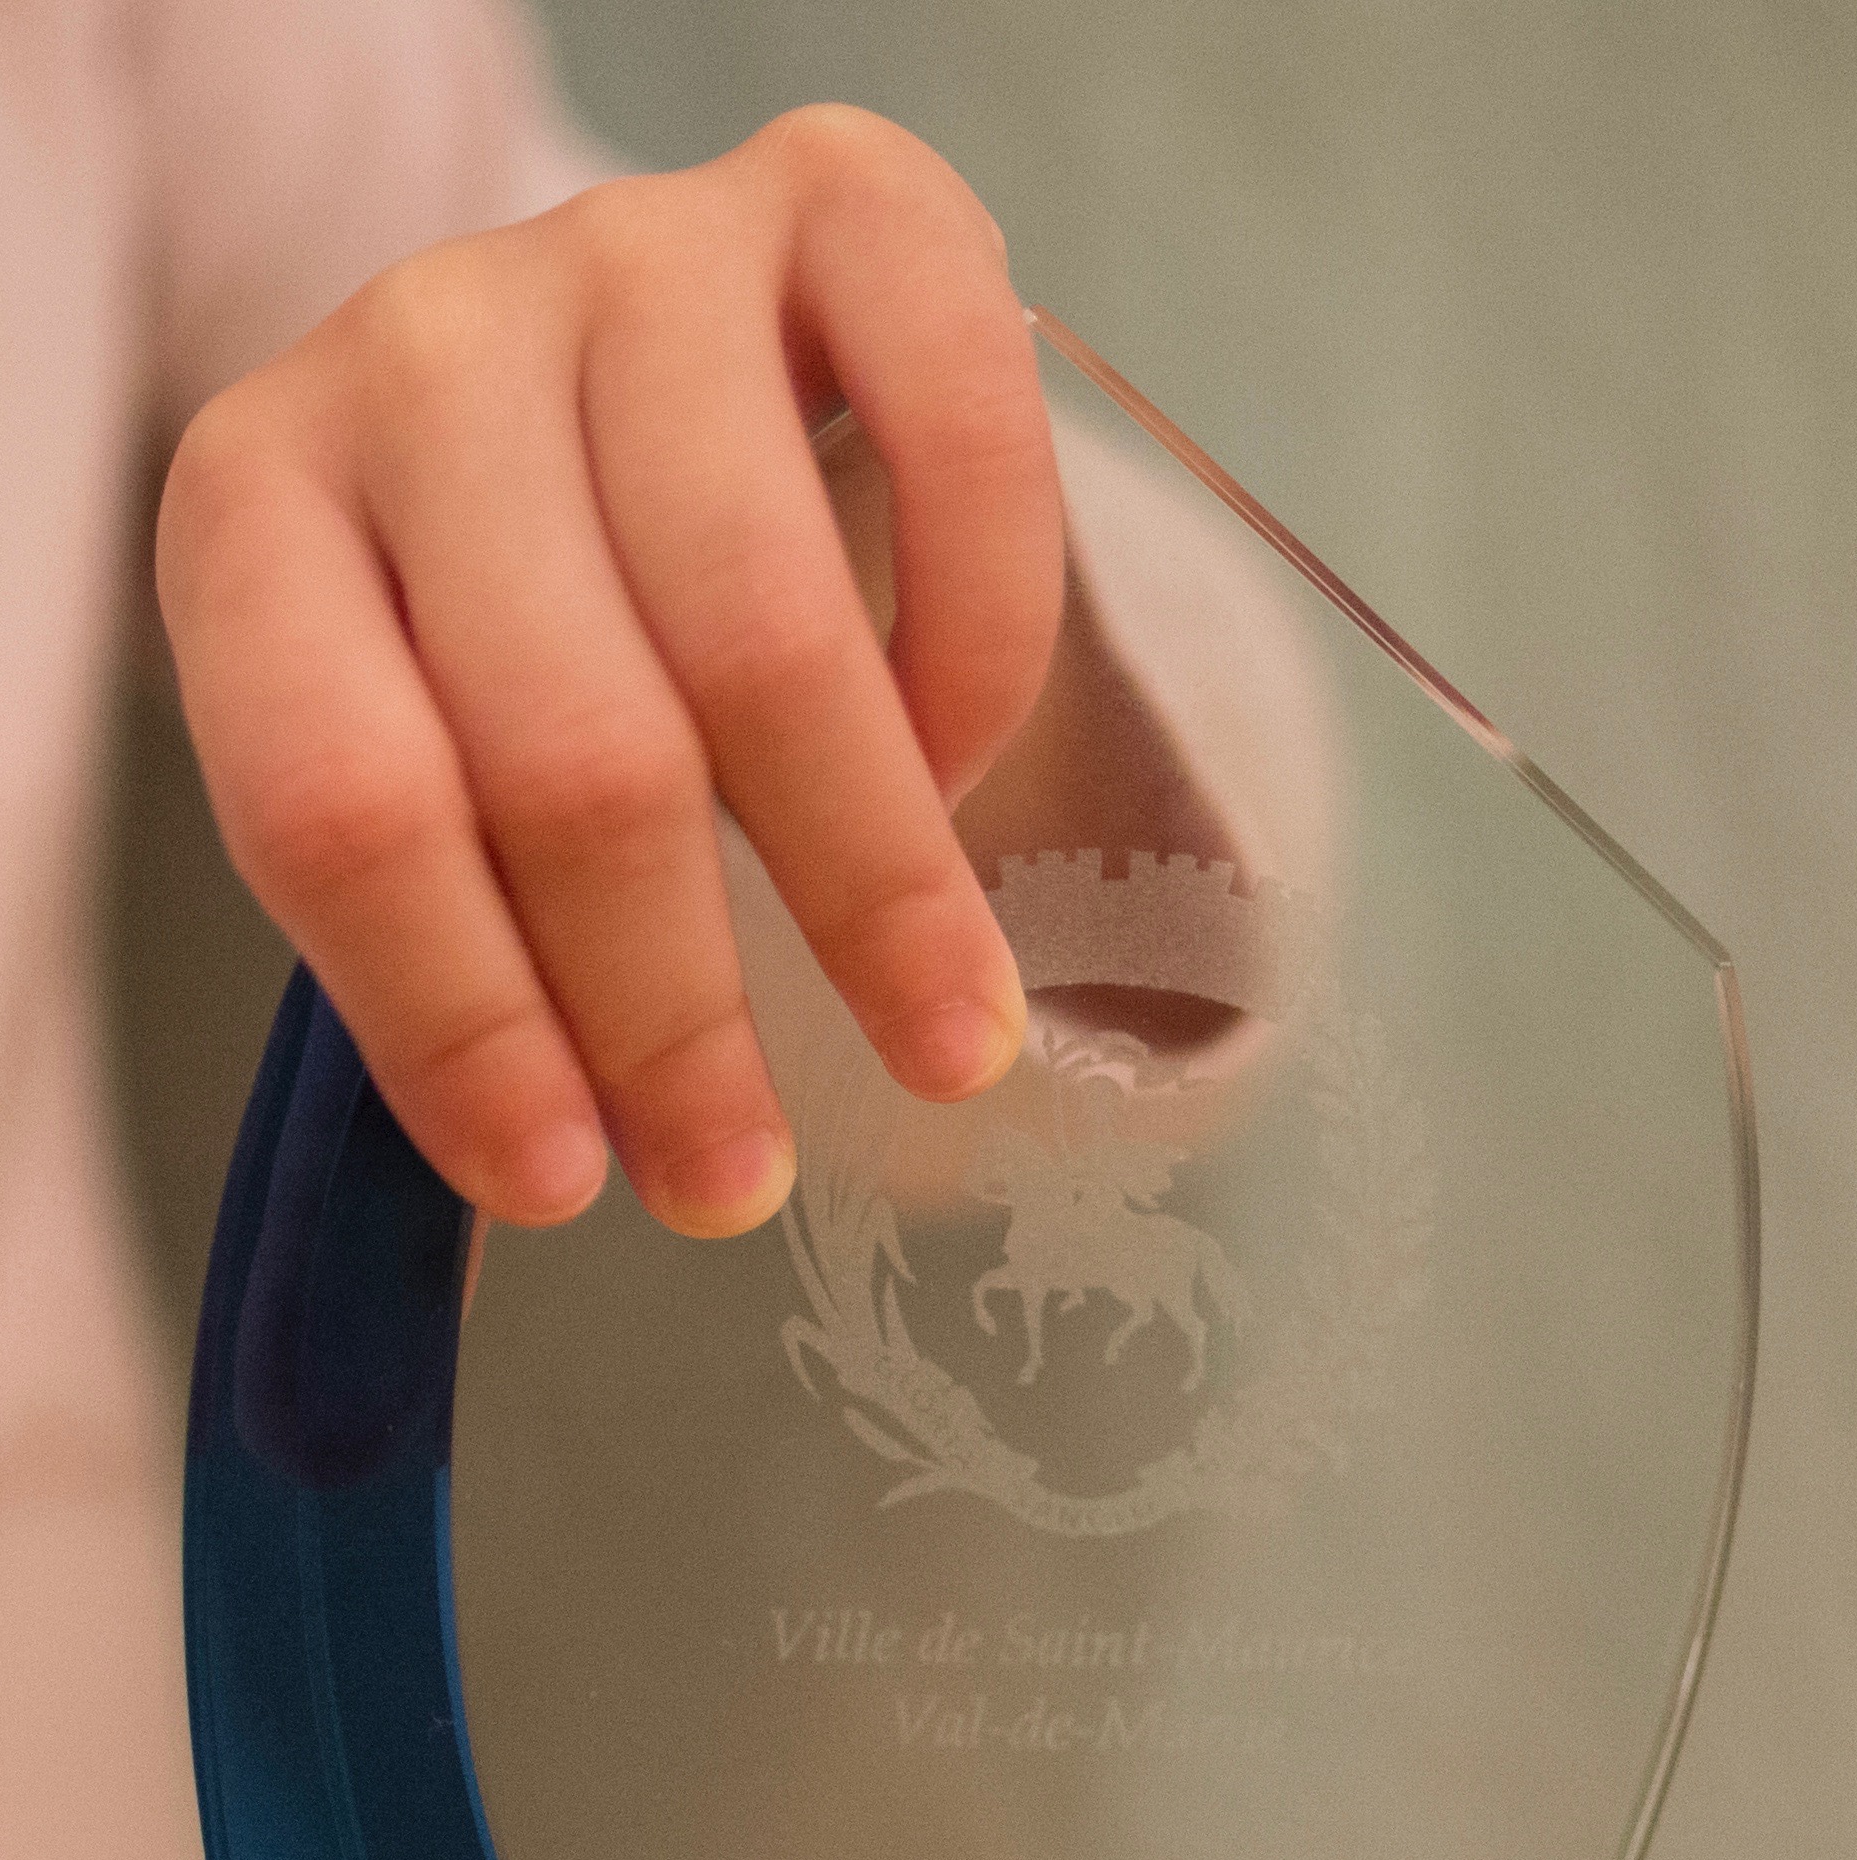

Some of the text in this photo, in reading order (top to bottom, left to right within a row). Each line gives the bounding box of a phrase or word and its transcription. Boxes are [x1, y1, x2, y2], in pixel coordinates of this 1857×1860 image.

[769, 1606, 1427, 1676] Ville de Saint-Maurice
[892, 1693, 1290, 1753] Val-de-Marne
